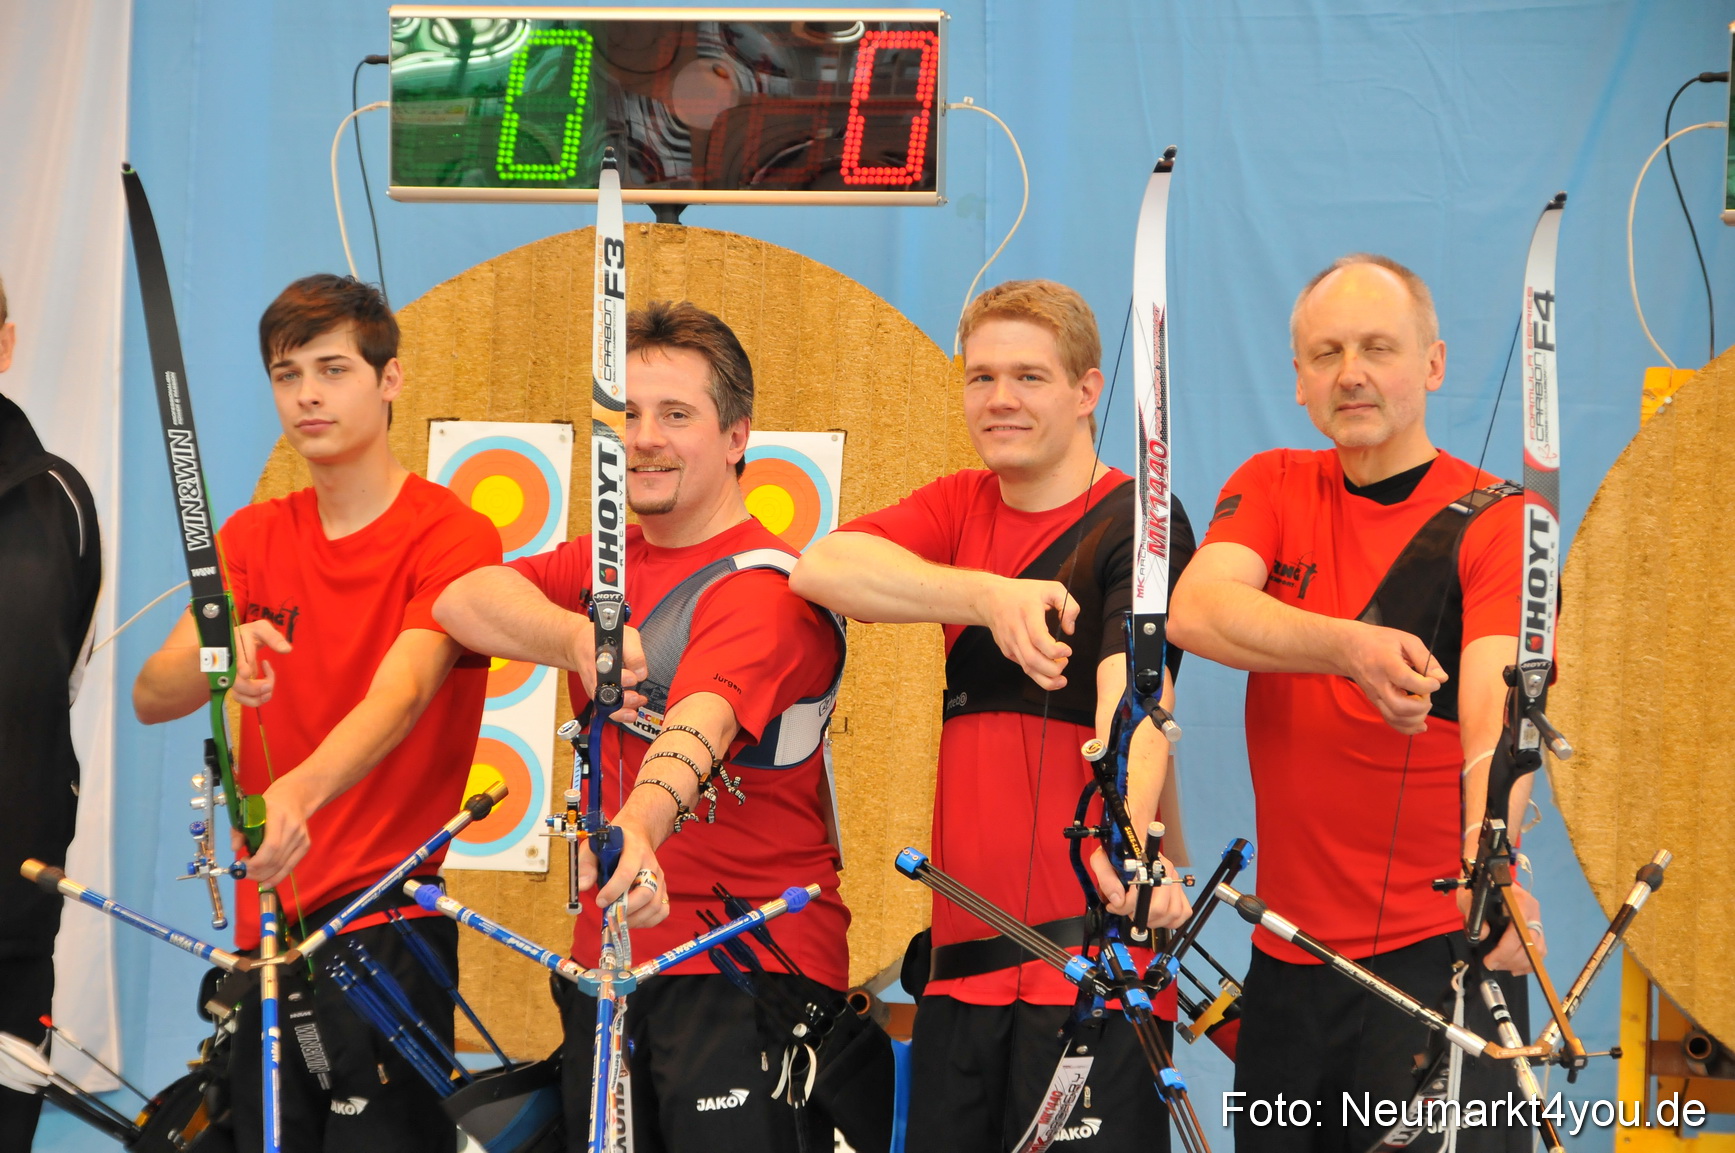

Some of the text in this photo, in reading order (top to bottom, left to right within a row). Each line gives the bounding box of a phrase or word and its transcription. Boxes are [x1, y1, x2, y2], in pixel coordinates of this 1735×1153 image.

[496, 29, 593, 180] 0
[839, 30, 939, 185] 0
[604, 237, 625, 300] F3
[1533, 289, 1556, 352] F4
[603, 299, 612, 381] CARBON
[1527, 355, 1535, 440] FORMULA
[1534, 352, 1544, 442] CARBON
[168, 429, 212, 551] WIN&WIN
[598, 440, 618, 563] HOYT
[1147, 437, 1170, 559] MK1440
[1527, 508, 1550, 630] HOYT
[696, 1094, 740, 1112] JAKO
